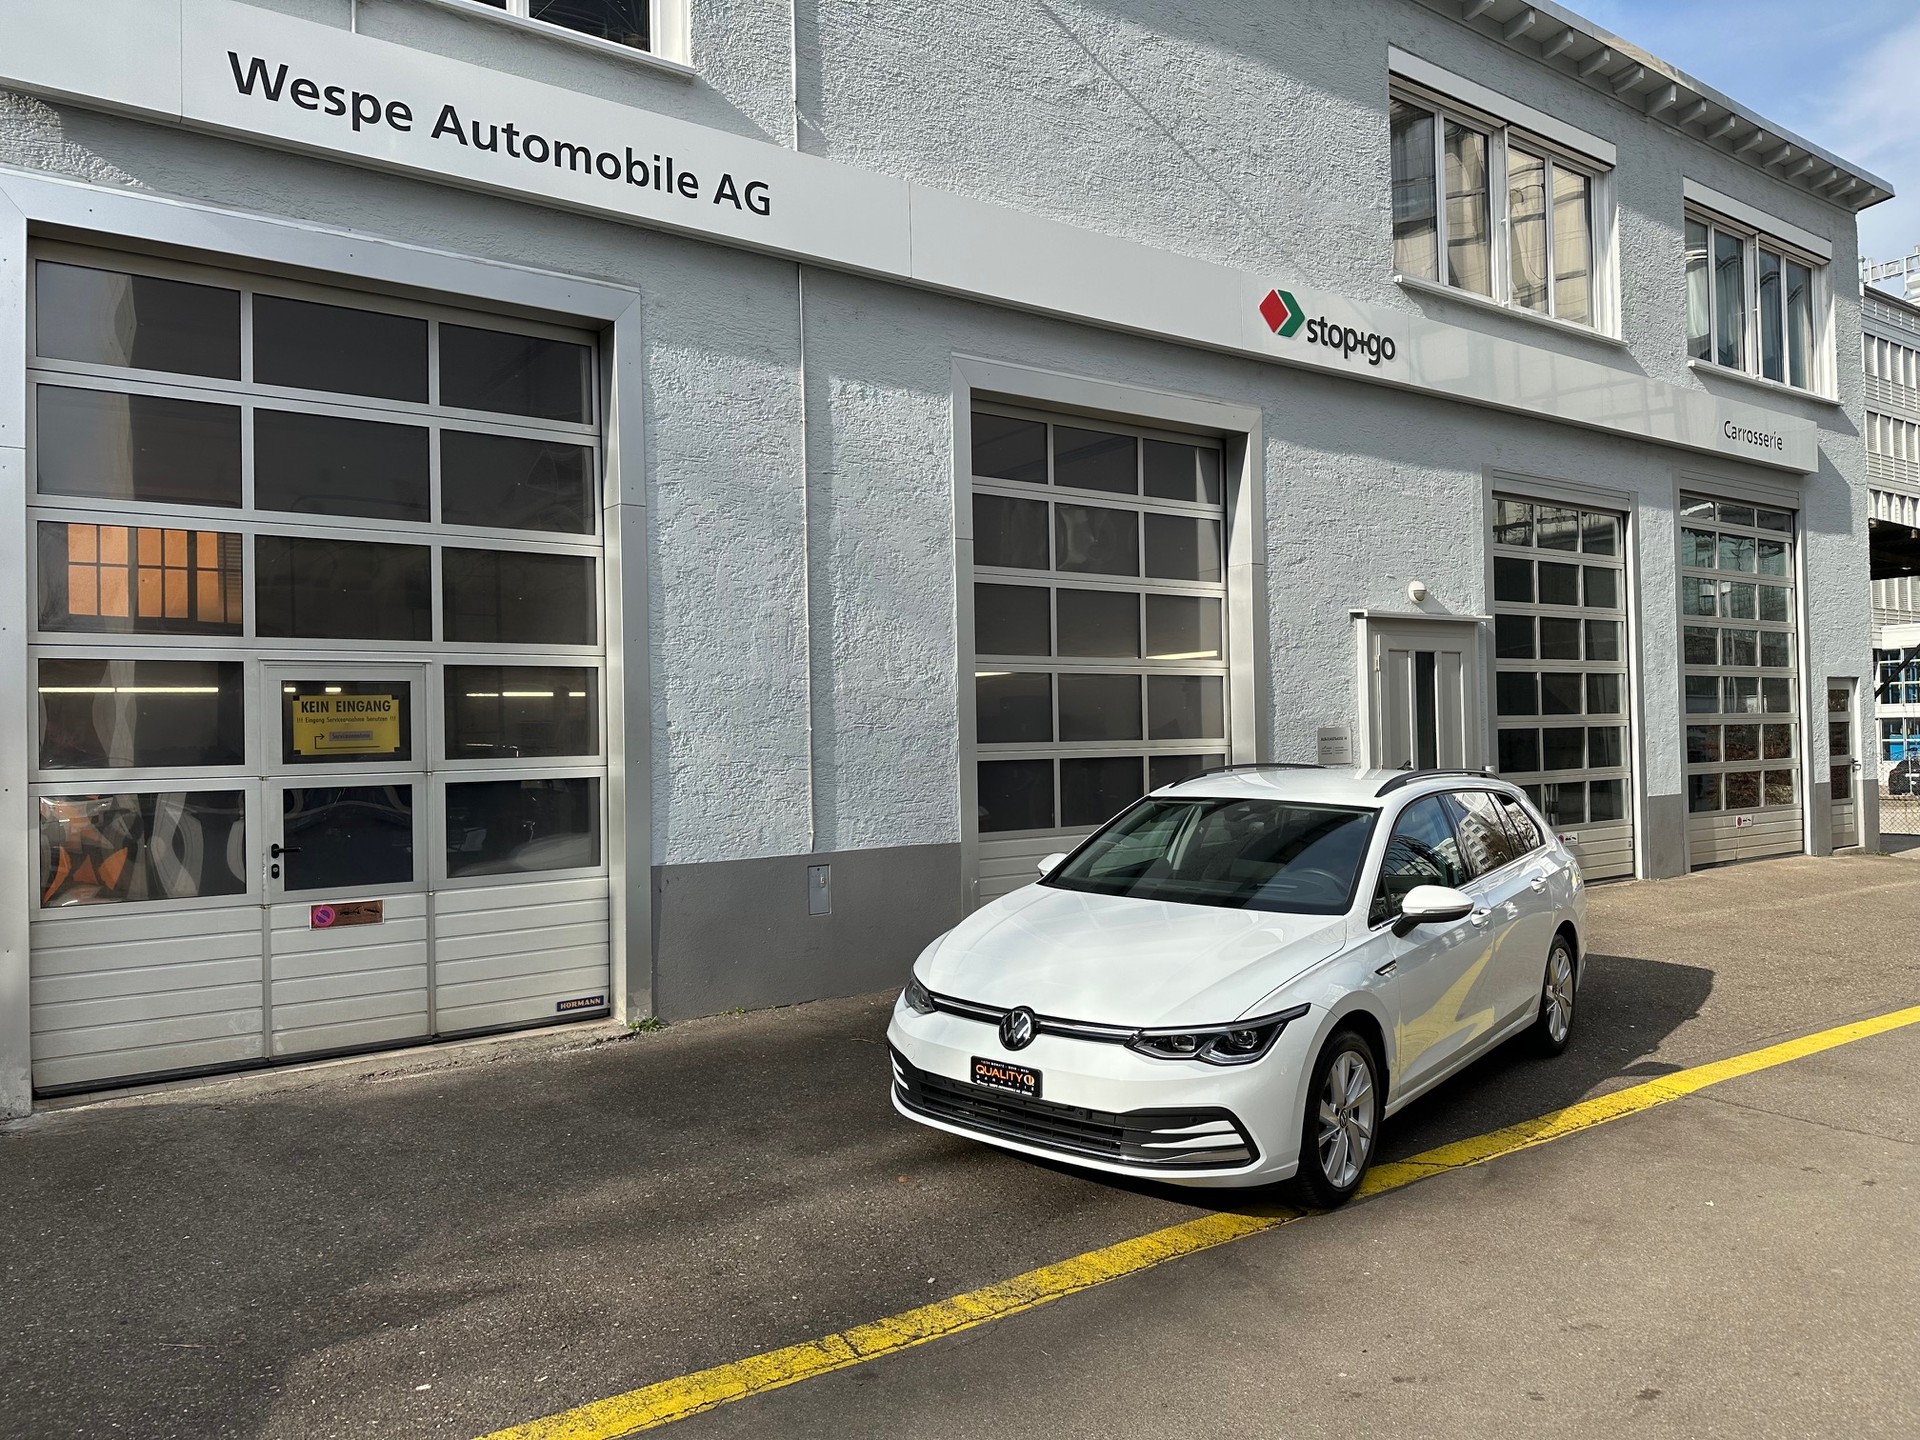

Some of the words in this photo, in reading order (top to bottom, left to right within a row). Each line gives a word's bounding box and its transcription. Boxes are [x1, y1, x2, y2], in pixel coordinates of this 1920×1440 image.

[227, 51, 413, 132] Wespe
[431, 104, 699, 199] Automobile
[713, 173, 770, 216] AG
[1307, 316, 1396, 366] stop+go
[1724, 420, 1783, 451] Carrosserie
[301, 701, 330, 713] KEIN
[336, 700, 391, 712] EINGANG
[976, 1064, 1023, 1083] QUALITY
